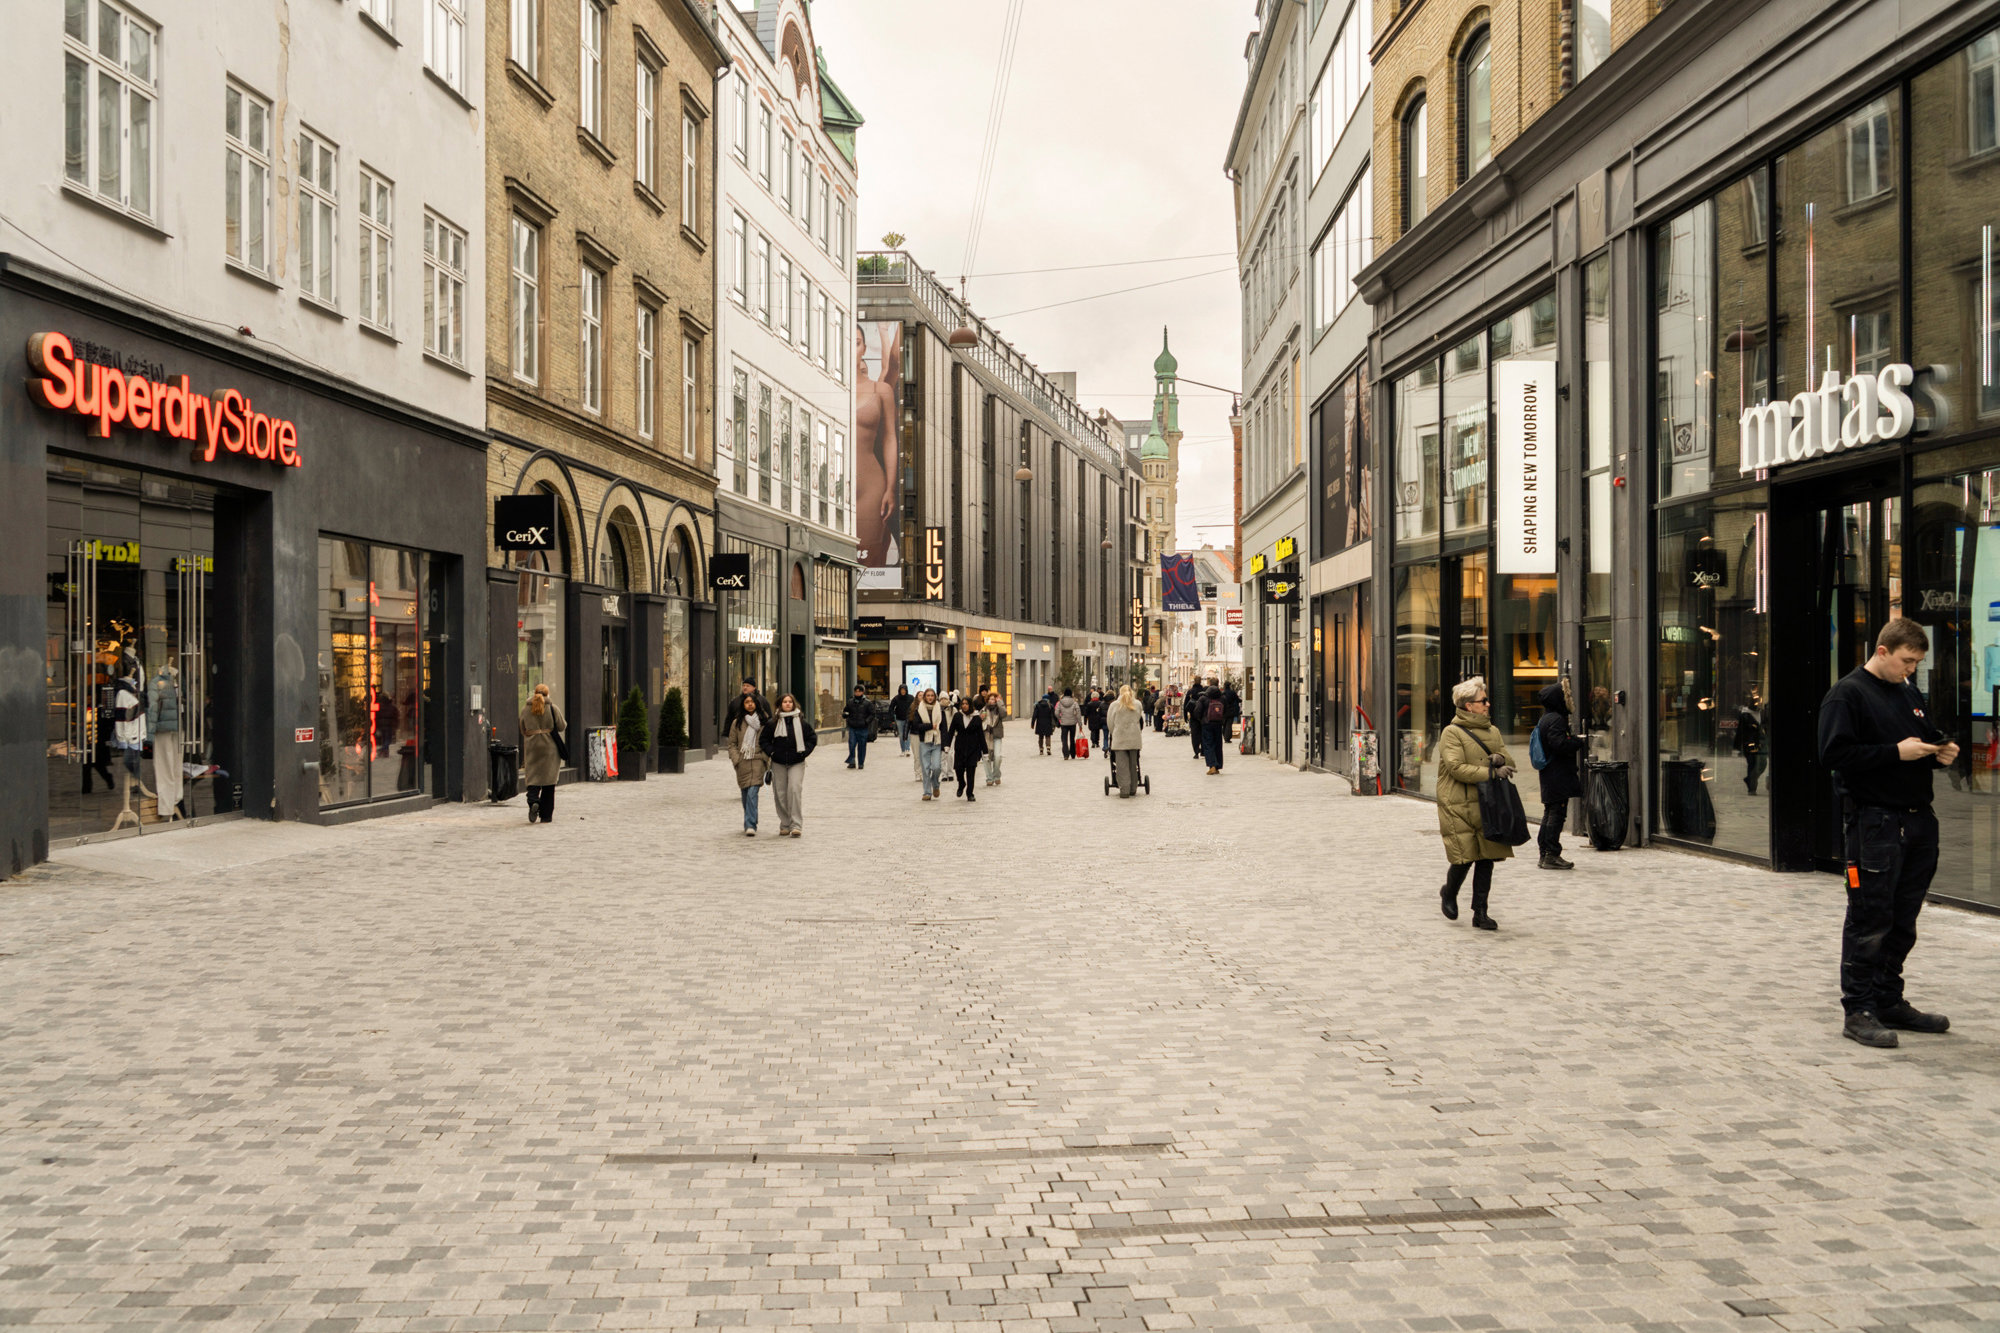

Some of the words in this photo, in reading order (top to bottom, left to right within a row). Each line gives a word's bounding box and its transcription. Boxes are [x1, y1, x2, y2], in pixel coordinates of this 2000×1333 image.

[1739, 363, 1914, 473] matas
[1464, 432, 1478, 458] NEW
[1523, 463, 1537, 491] NEW
[1523, 495, 1537, 554] SHAPING
[926, 529, 943, 600] ILLUM
[1133, 598, 1142, 635] ILLUM
